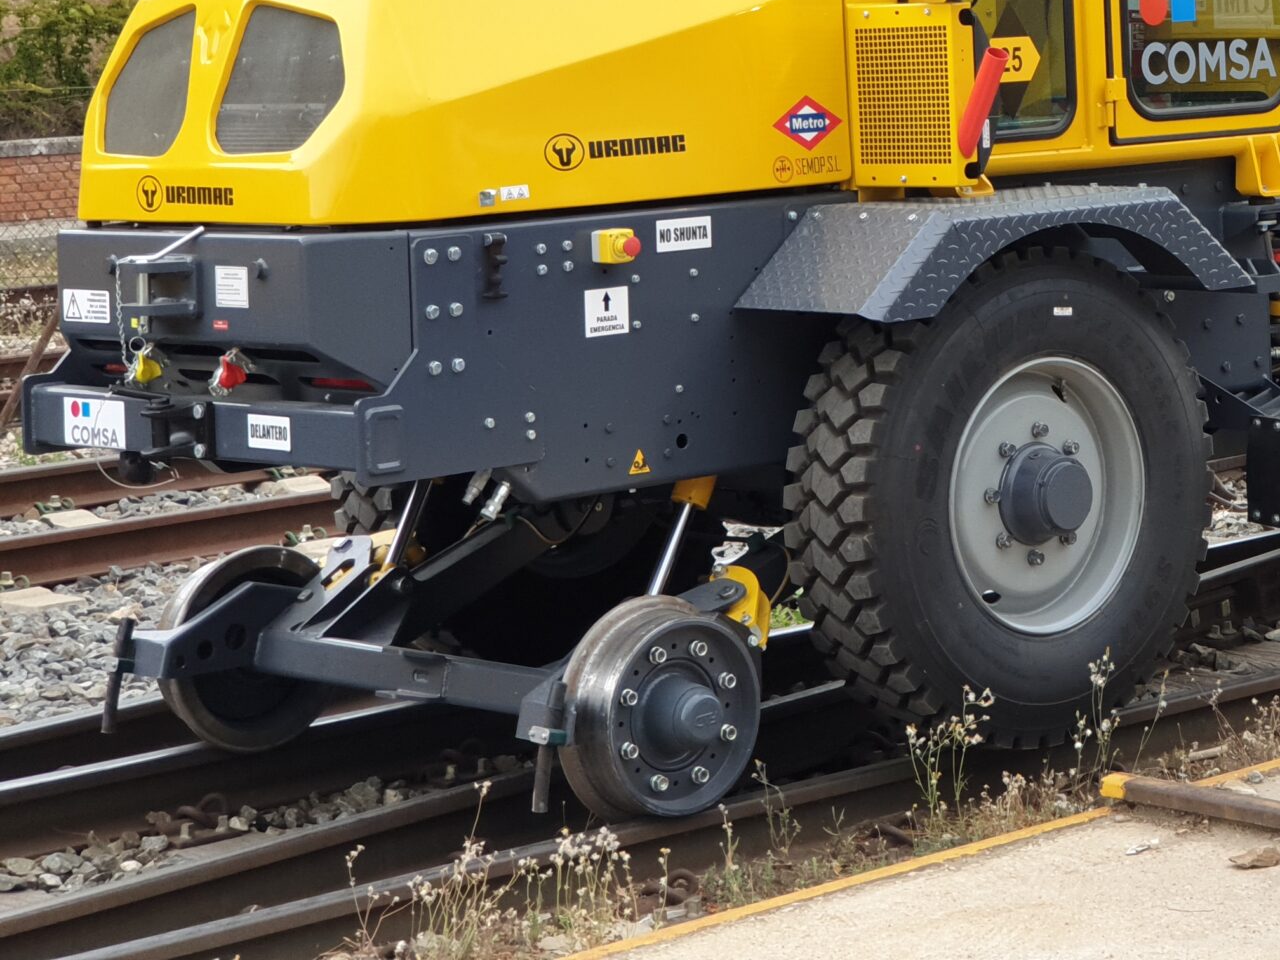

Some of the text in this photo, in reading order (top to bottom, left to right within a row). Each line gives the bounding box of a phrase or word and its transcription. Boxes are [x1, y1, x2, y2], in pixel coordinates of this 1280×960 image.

[1141, 37, 1277, 85] COMSA
[791, 117, 824, 130] Metro
[589, 134, 687, 161] UROMAC
[165, 185, 234, 207] UROMAC
[659, 225, 708, 243] NO SHUNTA
[590, 323, 625, 334] EMERGENCIA
[596, 315, 618, 323] PARADA
[71, 424, 119, 447] COMSA
[251, 423, 288, 442] DELANTERO
